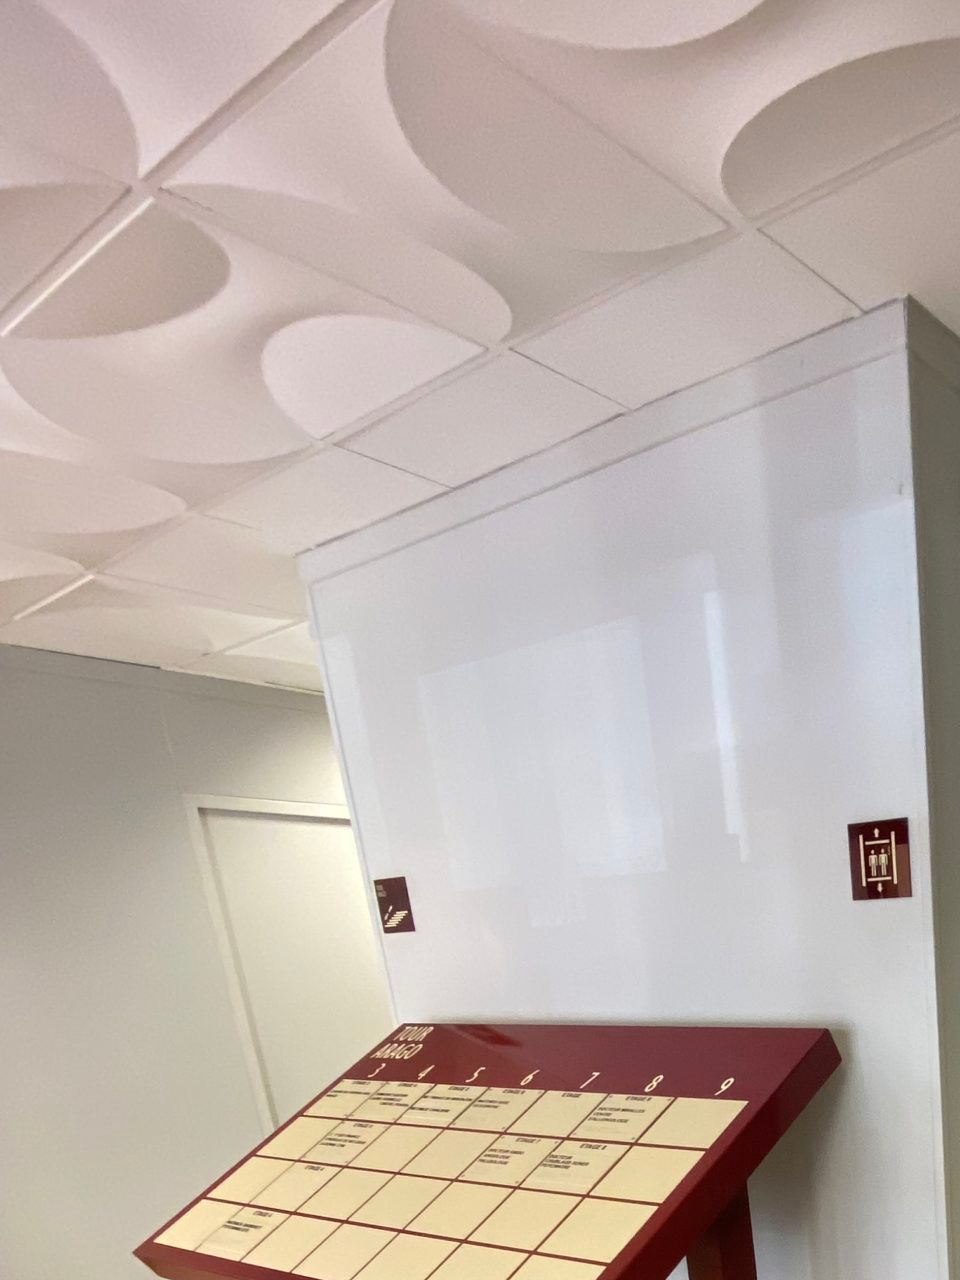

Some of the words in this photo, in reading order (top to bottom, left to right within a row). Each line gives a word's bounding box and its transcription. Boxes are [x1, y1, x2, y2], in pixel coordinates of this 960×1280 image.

[393, 1026, 434, 1042] TOUR
[370, 1043, 423, 1060] ARAGO
[367, 1063, 386, 1078] 3
[418, 1064, 435, 1080] 4
[465, 1066, 486, 1083] 5
[520, 1069, 540, 1086] 6
[579, 1071, 600, 1089] 7
[644, 1074, 664, 1093] 8
[714, 1077, 735, 1096] 9
